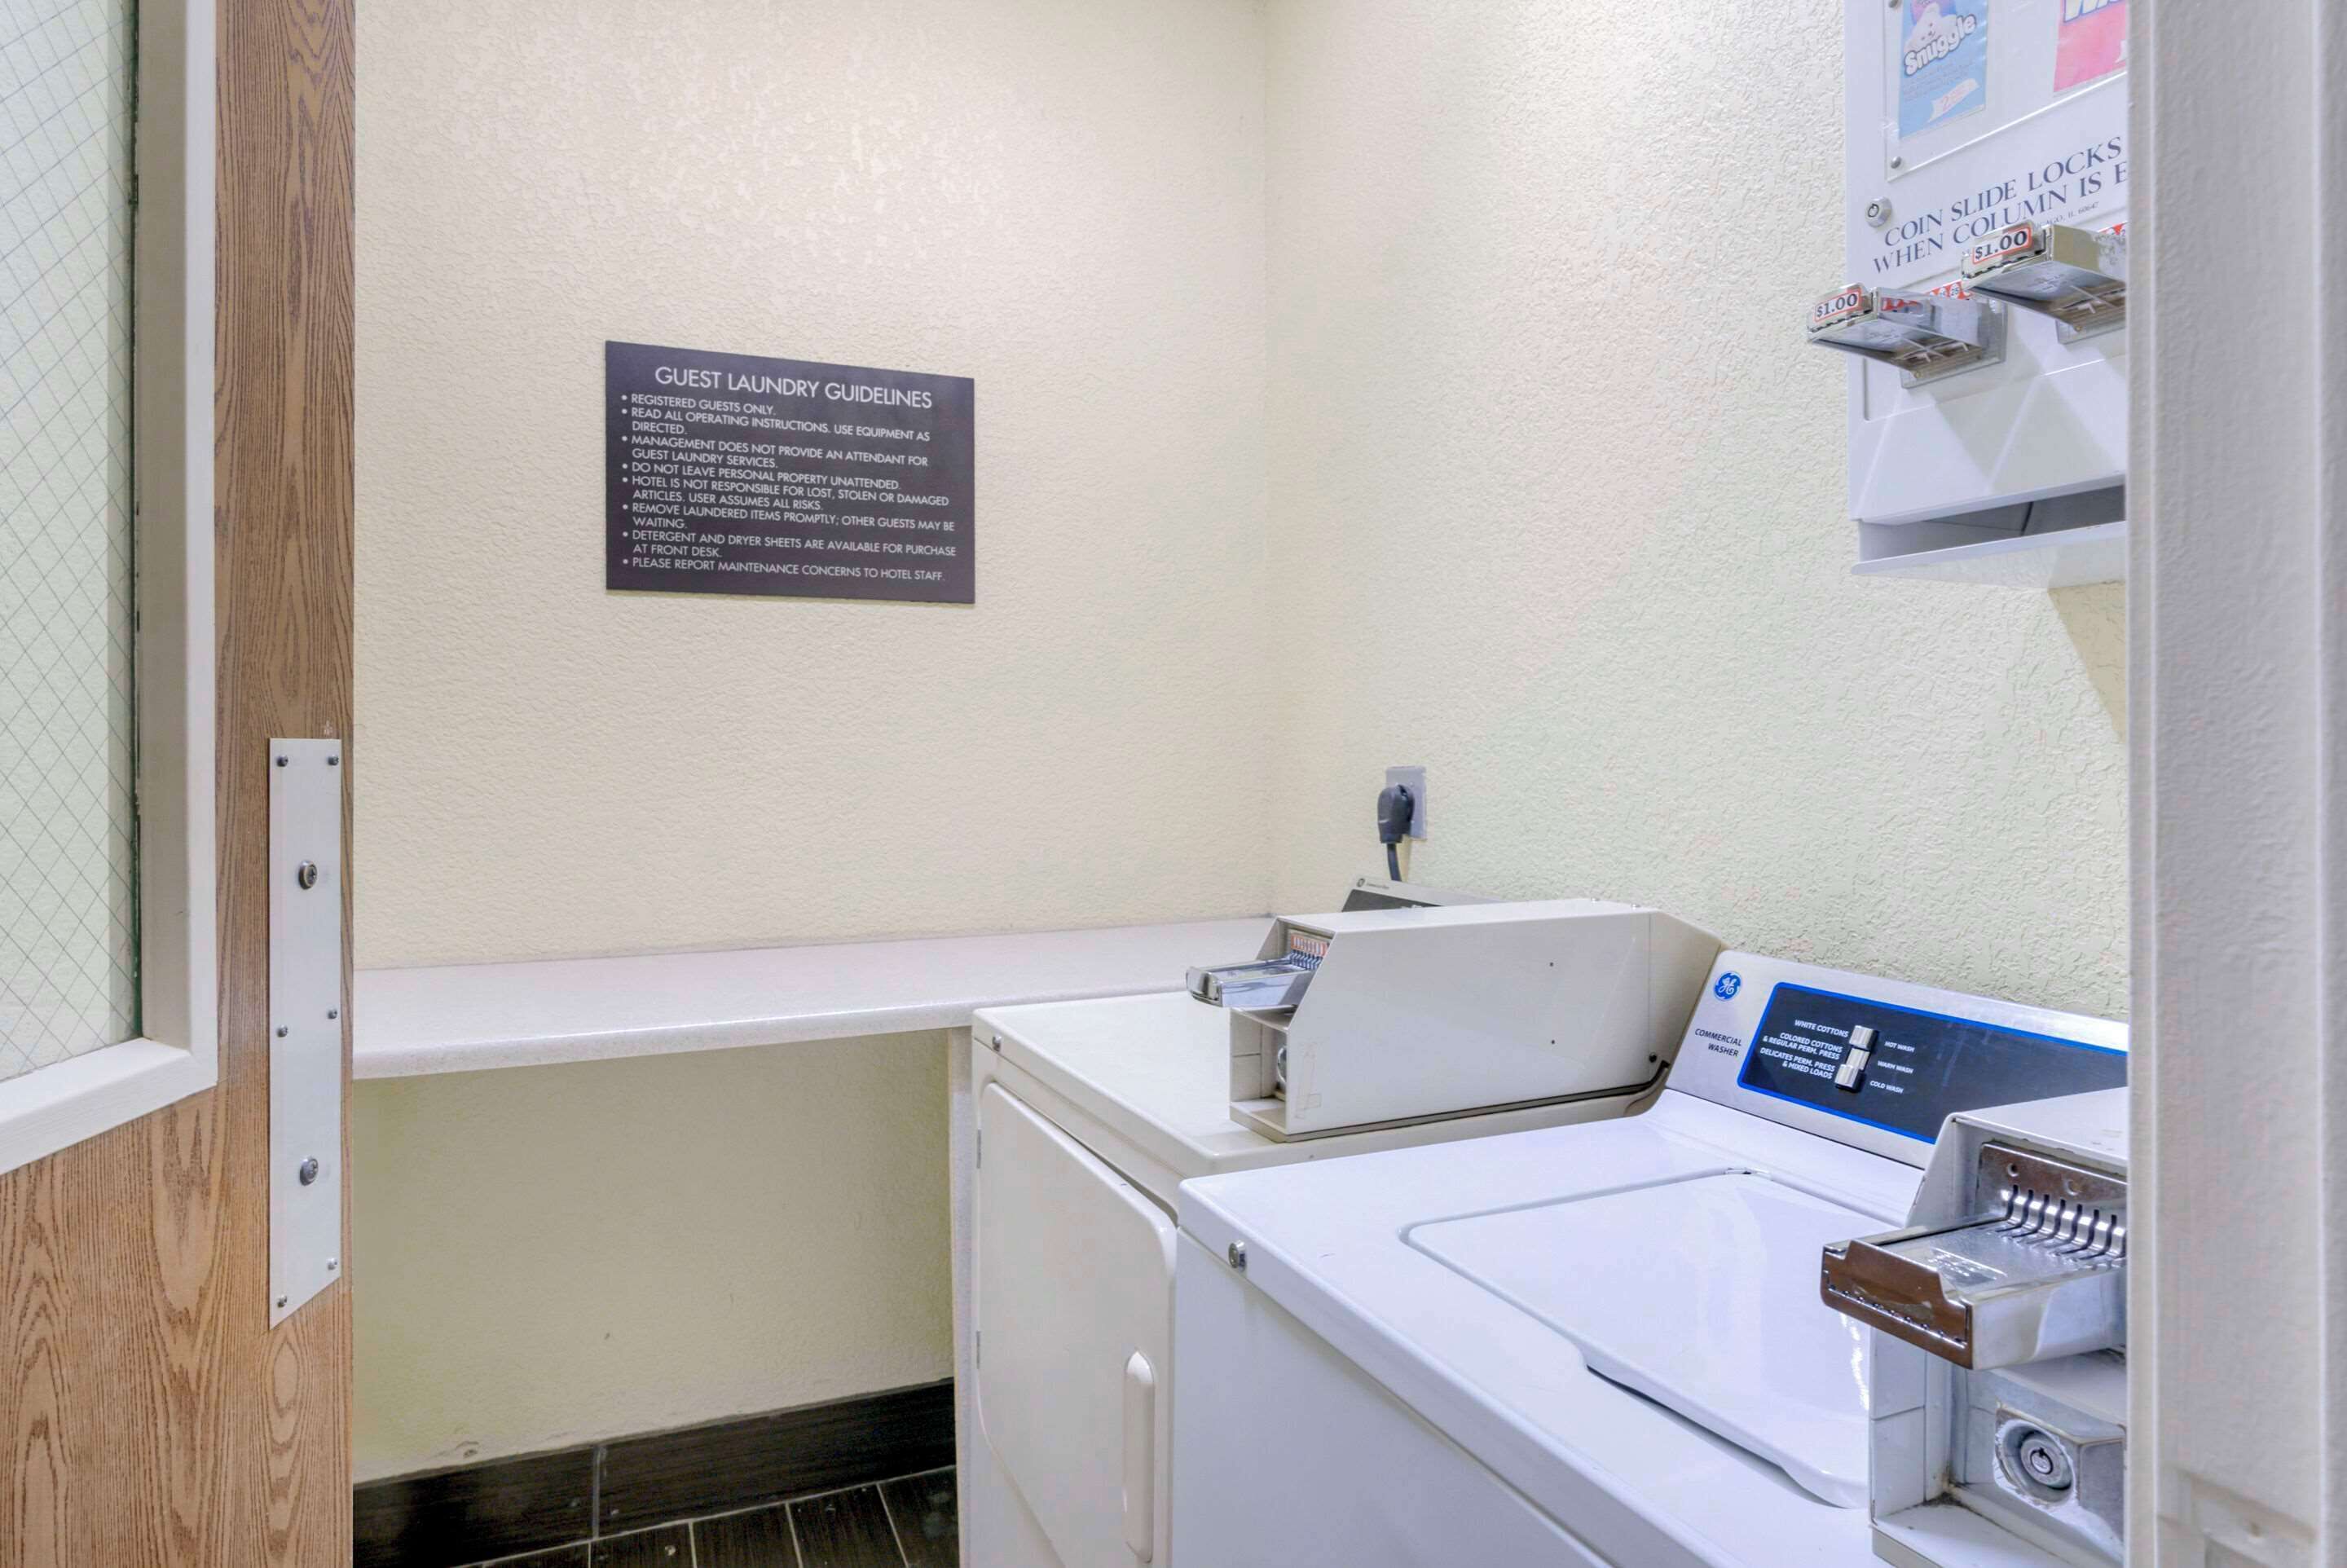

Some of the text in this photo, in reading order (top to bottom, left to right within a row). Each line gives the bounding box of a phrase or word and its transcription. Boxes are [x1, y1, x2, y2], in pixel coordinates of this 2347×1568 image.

[1903, 13, 1977, 76] Snuggle
[1885, 136, 2122, 247] COIN SLIDE LOCKS
[1874, 233, 1944, 274] WHEN
[1953, 184, 2067, 244] COLUMN
[2079, 171, 2102, 199] IS
[1975, 231, 2028, 261] $1.00
[1816, 293, 1858, 318] $1.00
[655, 366, 931, 407] GUEST LAUNDRY GUIDELINES
[632, 394, 775, 415] REGISTERED GUESTS ONLY.
[632, 407, 929, 441] READ ALL OPERATING INSTRUCTIONS. USE EQUIPMENT AS
[632, 421, 686, 434] DIRECTED.
[632, 434, 927, 466] MANAGEMENT DOES NOT PROVIDE AN ATTENDANT FOR
[632, 448, 777, 467] GUEST LAUNDRY SERVICES.
[632, 461, 900, 489] DO NOT LEAVE PERSONAL PROPERTY UNATTENDED.
[632, 475, 948, 505] HOTEL IS NOT RESPONSIBLE FOR LOST, STOLEN OR DAMAGED
[633, 488, 822, 509] ARTICLES. USER ASSUMES ALL RISKS.
[632, 502, 953, 531] REMOVE LAUNDERED ITEMS PROMPTLY; OTHER GUESTS MAY BE
[632, 516, 686, 528] WAITING.
[632, 530, 955, 556] DETERGENT AND DRYER SHEETS ARE AVAILABLE FOR PURCHASE
[633, 543, 721, 557] AT FRONT DESK.
[632, 557, 945, 580] PLEASE REPORT MAINTENANCE CONCERNS TO HOTEL STAFF.
[1695, 1028, 1742, 1046] COMMERCIAL
[1794, 1020, 1849, 1038] WHITE COTTONS
[1708, 1043, 1739, 1056] WASHER
[1768, 1037, 1798, 1050] REGULAR
[1798, 1043, 1817, 1055] PERM.
[1819, 1049, 1840, 1060] PRESS
[1780, 1032, 1843, 1053] COLORED COTTONS
[1884, 1041, 1915, 1052] HOT WASH
[1760, 1047, 1835, 1072] DELICATES PERM. PRESS
[1788, 1063, 1809, 1073] MIXED
[1810, 1068, 1834, 1079] LOADS
[1877, 1060, 1914, 1074] WARM WASH
[1869, 1080, 1904, 1094] COLD WASH
